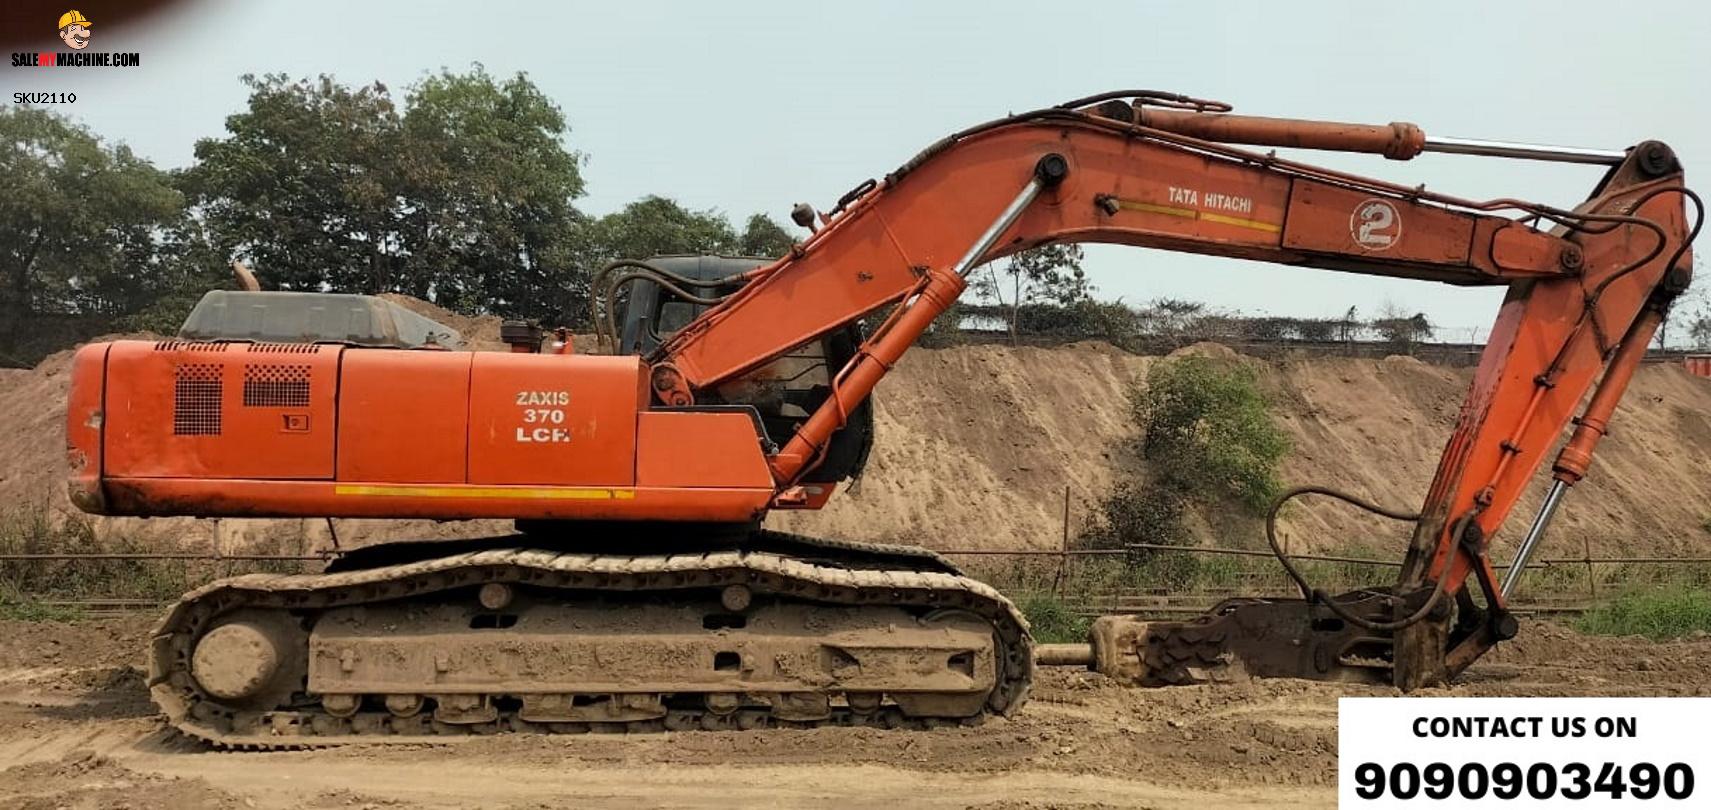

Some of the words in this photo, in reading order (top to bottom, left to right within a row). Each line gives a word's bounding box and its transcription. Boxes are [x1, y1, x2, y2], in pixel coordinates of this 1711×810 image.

[1168, 186, 1198, 205] TATA
[1204, 192, 1251, 213] HITACHI
[1359, 203, 1394, 244] 2
[516, 391, 570, 406] ZAXIS
[523, 408, 565, 424] 370
